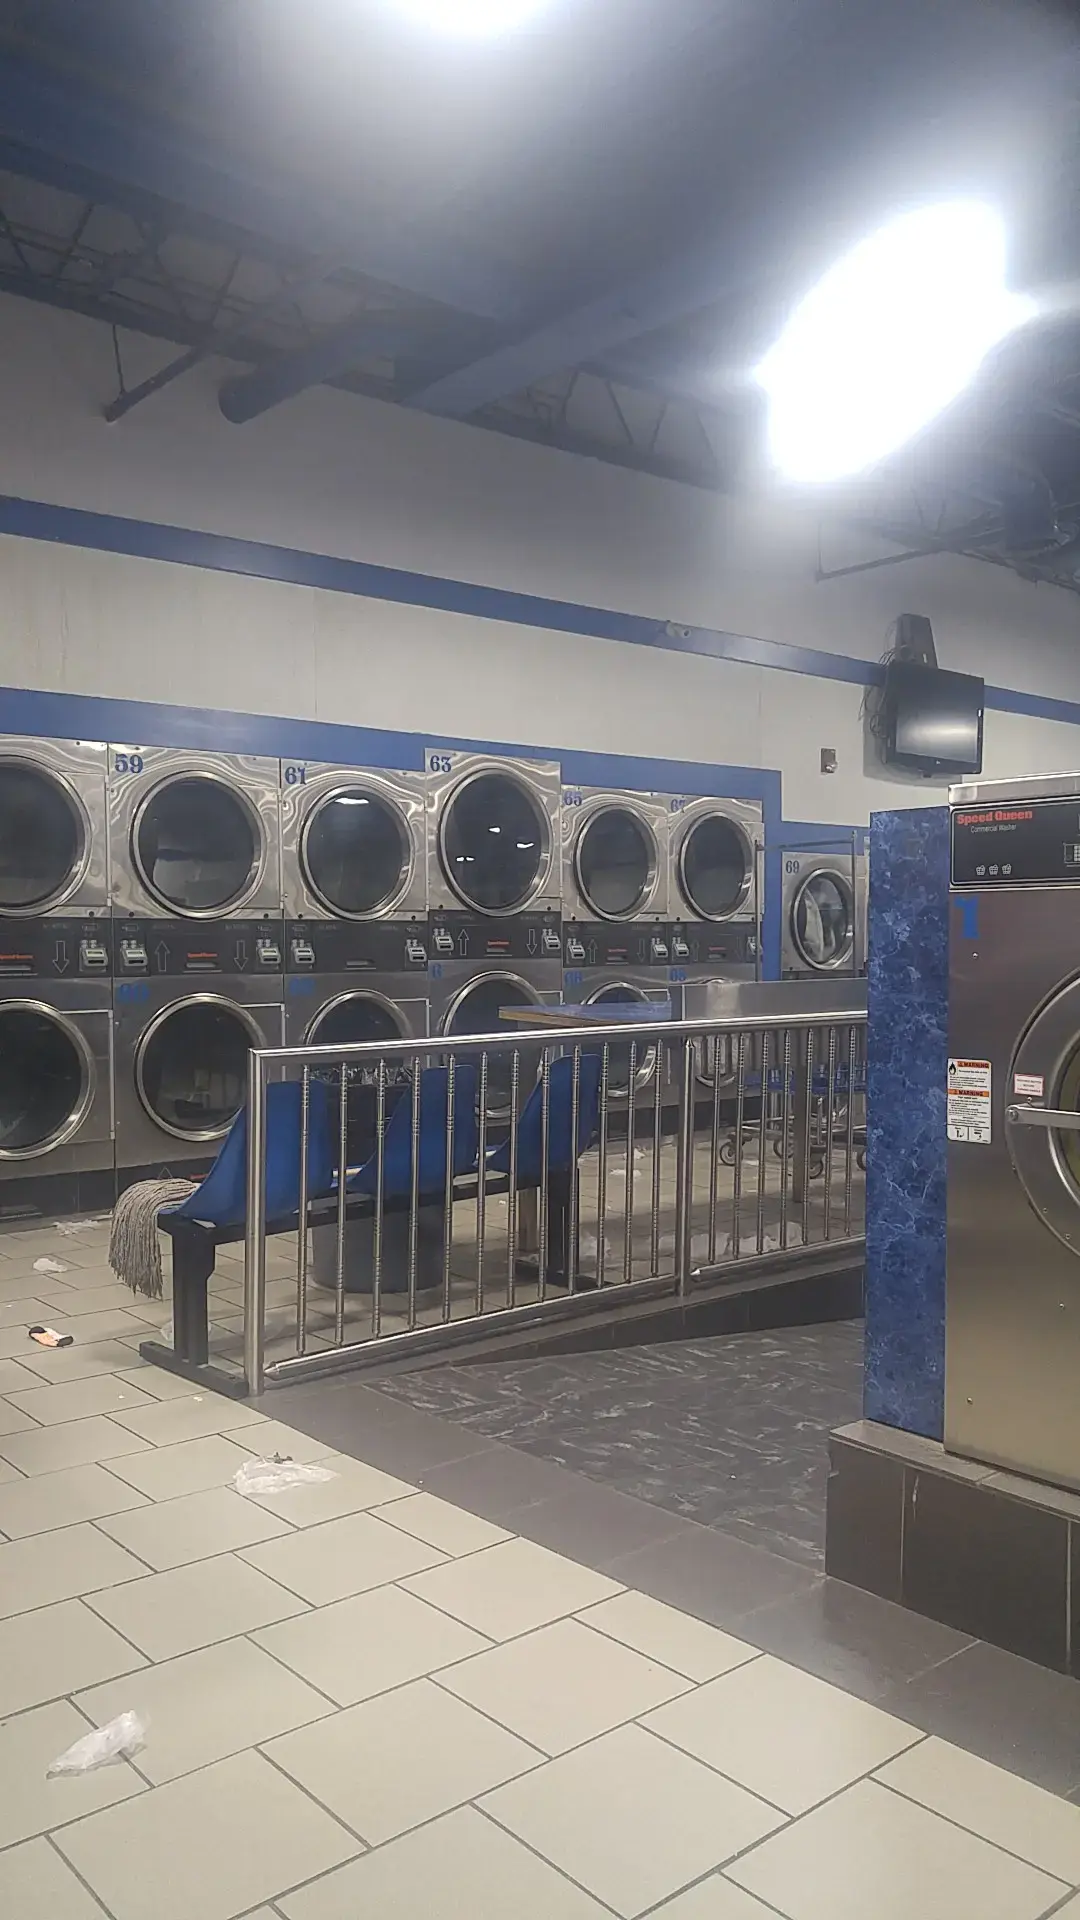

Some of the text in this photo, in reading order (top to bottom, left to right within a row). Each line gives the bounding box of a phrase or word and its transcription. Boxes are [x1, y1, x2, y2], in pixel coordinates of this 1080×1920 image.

[115, 753, 143, 773] 59
[430, 755, 452, 773] 63
[285, 766, 306, 785] 61
[563, 791, 582, 806] 65
[957, 810, 1033, 826] Speed Queen
[971, 823, 1017, 834] Commercial Washer
[786, 860, 800, 873] 69
